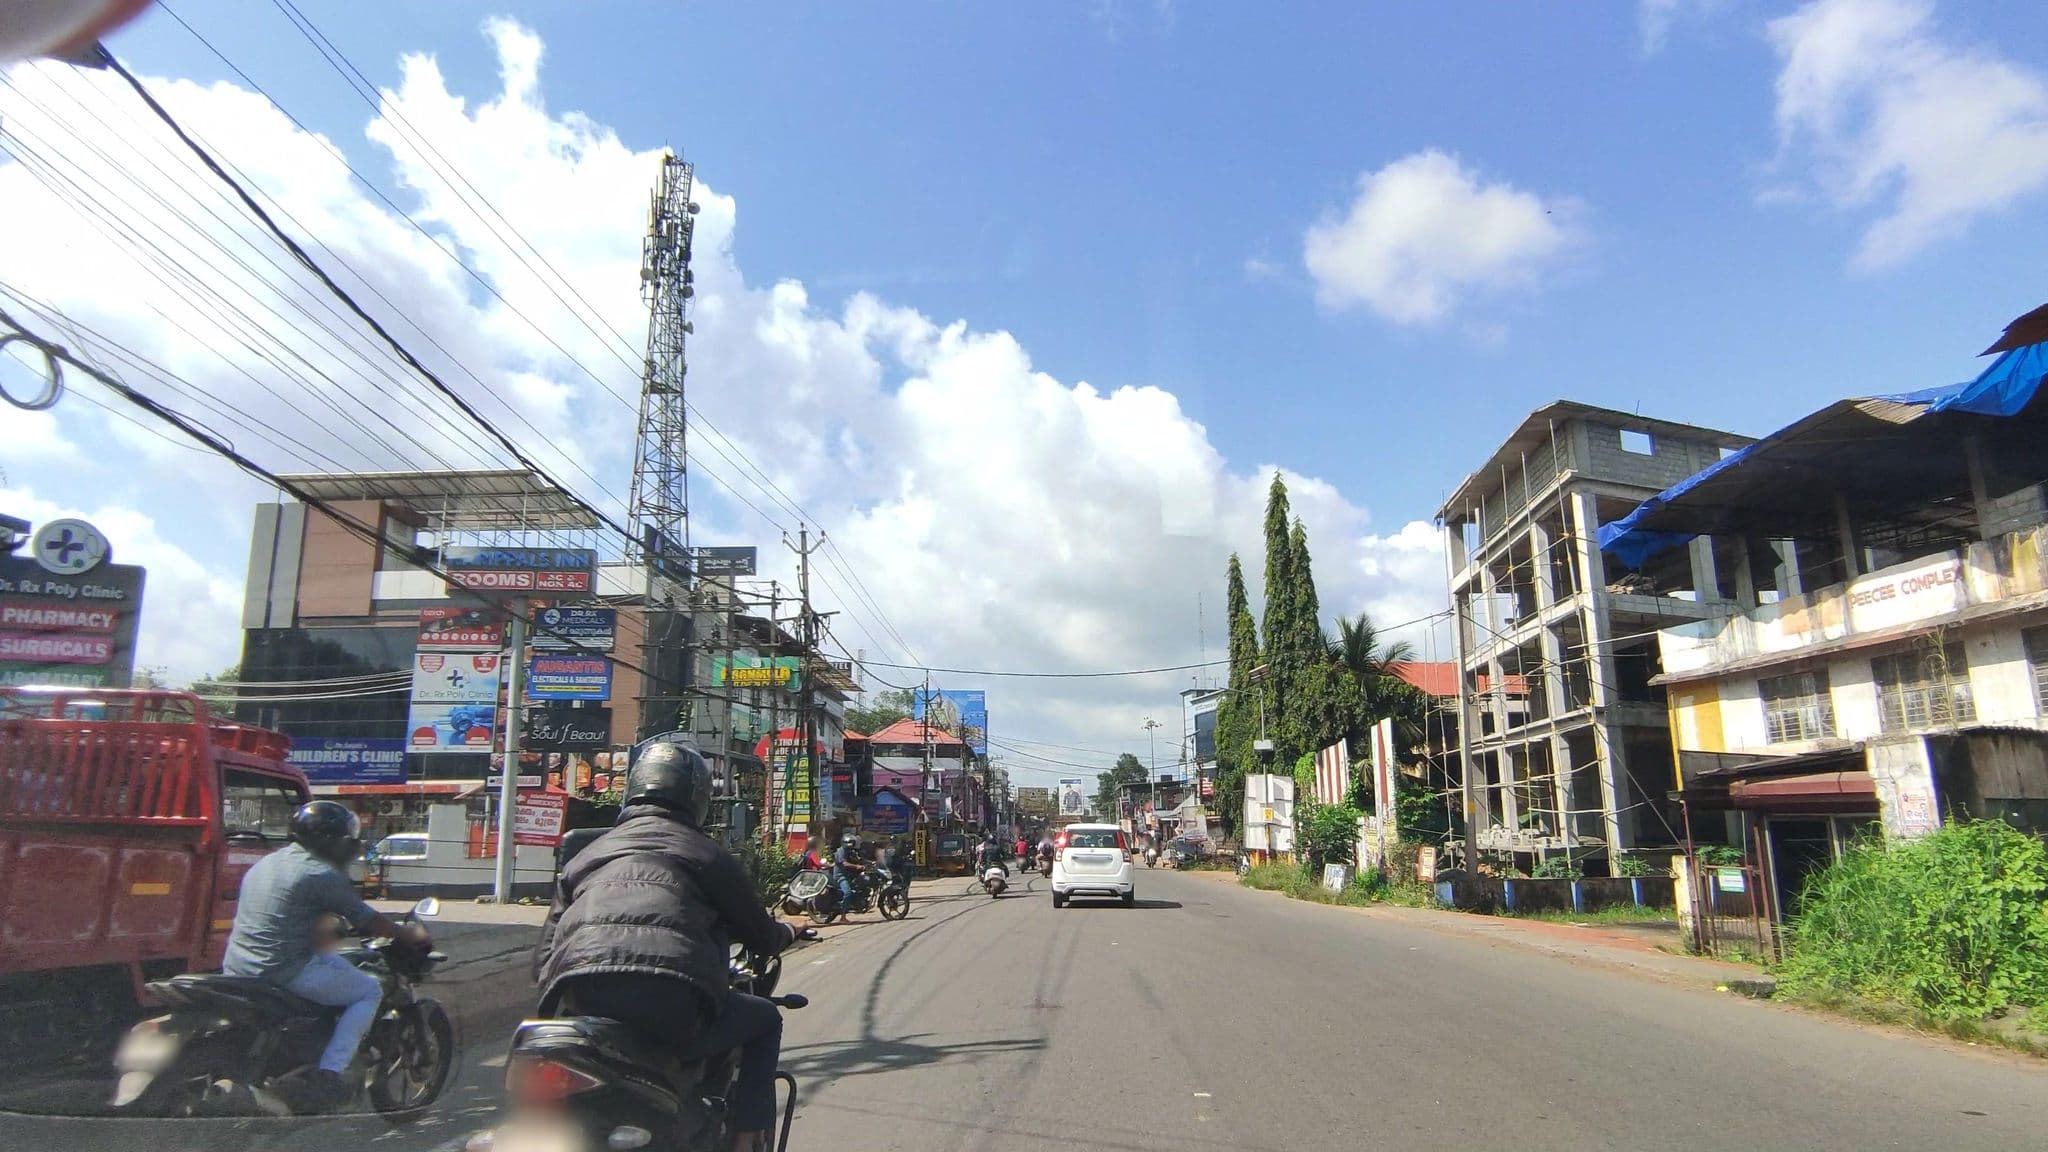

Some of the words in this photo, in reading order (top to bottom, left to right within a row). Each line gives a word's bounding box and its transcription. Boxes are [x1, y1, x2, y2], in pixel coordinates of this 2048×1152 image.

[451, 573, 530, 586] ROOMS
[45, 581, 78, 598] Poly
[81, 584, 124, 599] Clinic
[1848, 584, 1896, 608] PEECEE
[3, 607, 114, 628] PHARMACY
[0, 638, 108, 658] SURGICALS
[531, 729, 559, 740] Soul
[361, 751, 404, 763] CLINIC
